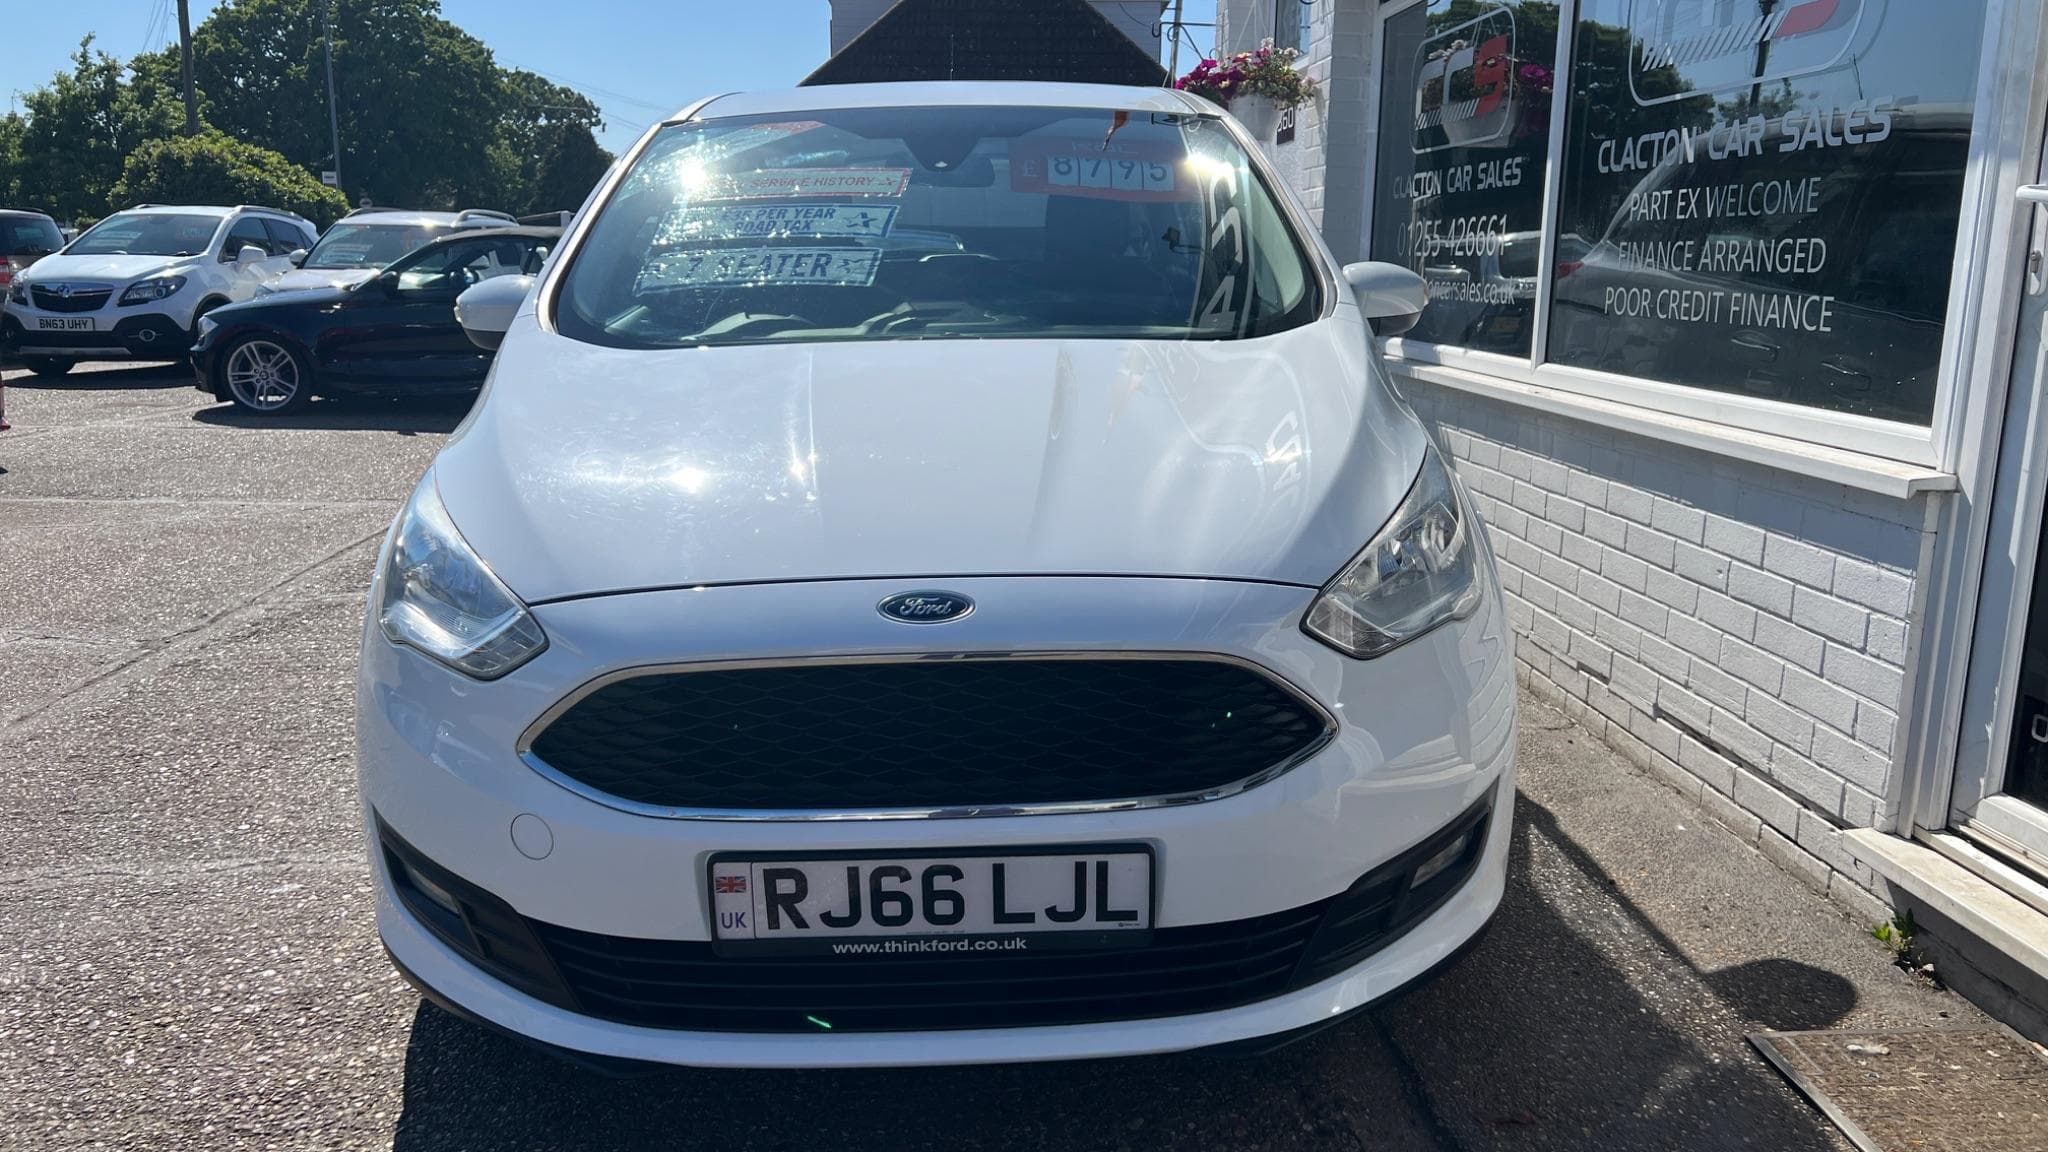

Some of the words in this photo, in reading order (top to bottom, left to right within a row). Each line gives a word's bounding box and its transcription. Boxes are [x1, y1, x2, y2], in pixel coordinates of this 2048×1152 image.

[1598, 125, 1698, 174] CLACTON
[1708, 113, 1767, 161] CAR
[1779, 95, 1894, 153] SALES
[750, 176, 811, 188] SERVICE
[814, 175, 875, 187] HISTORY
[1054, 156, 1168, 182] 8795
[1393, 169, 1442, 198] CLACTON
[1447, 165, 1473, 193] CAR
[1477, 156, 1522, 190] SALES
[1629, 189, 1672, 222] PART
[1676, 187, 1700, 219] EX
[1706, 177, 1822, 218] WELCOME
[734, 219, 777, 233] ROAD
[784, 219, 815, 232] TAX
[756, 207, 789, 220] PER
[794, 207, 837, 220] YEAR
[1397, 219, 1442, 257] 01255
[1445, 214, 1508, 257] 426661
[717, 253, 834, 278] SEATER
[1618, 241, 1695, 272] FINANCE
[1698, 238, 1827, 273] ARRANGED
[1604, 286, 1652, 318] POOR
[1656, 289, 1725, 324] CREDIT
[1729, 292, 1835, 332] FINANCE
[39, 319, 65, 329] BN63
[67, 319, 88, 329] UHY
[899, 596, 953, 616] Ford
[762, 864, 965, 931] RJ66
[992, 860, 1139, 925] LJL
[720, 911, 748, 929] UK
[832, 937, 1028, 955] www.thinkford.co.uk
